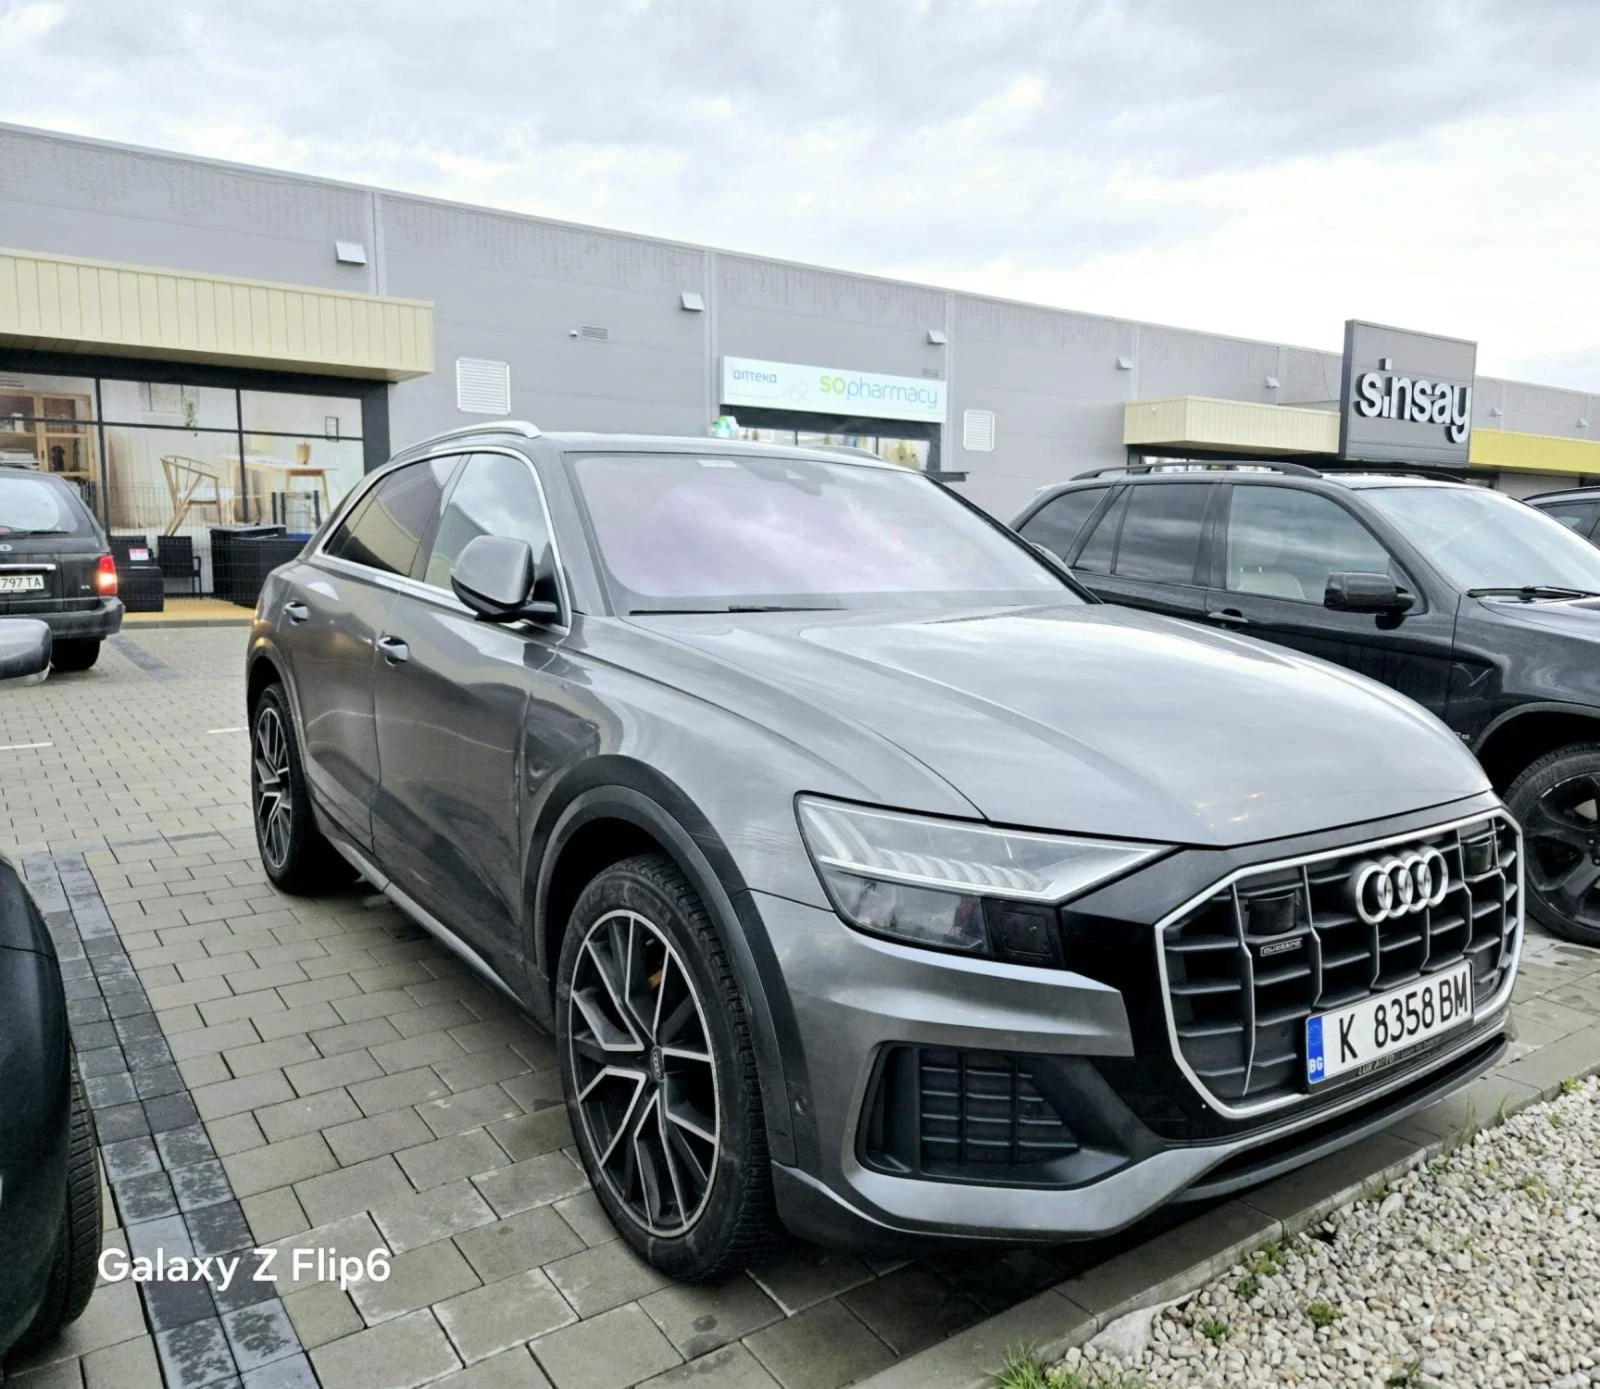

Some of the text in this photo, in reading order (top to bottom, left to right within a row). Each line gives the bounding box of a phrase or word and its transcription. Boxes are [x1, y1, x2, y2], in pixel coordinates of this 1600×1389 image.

[733, 367, 777, 384] аптека
[819, 374, 938, 409] sopharmacy
[1357, 358, 1473, 443] sinsay
[26, 576, 42, 588] TA
[1339, 1013, 1358, 1063] K
[1374, 987, 1433, 1048] 8358
[1439, 970, 1468, 1023] BM
[1309, 1057, 1323, 1073] BG
